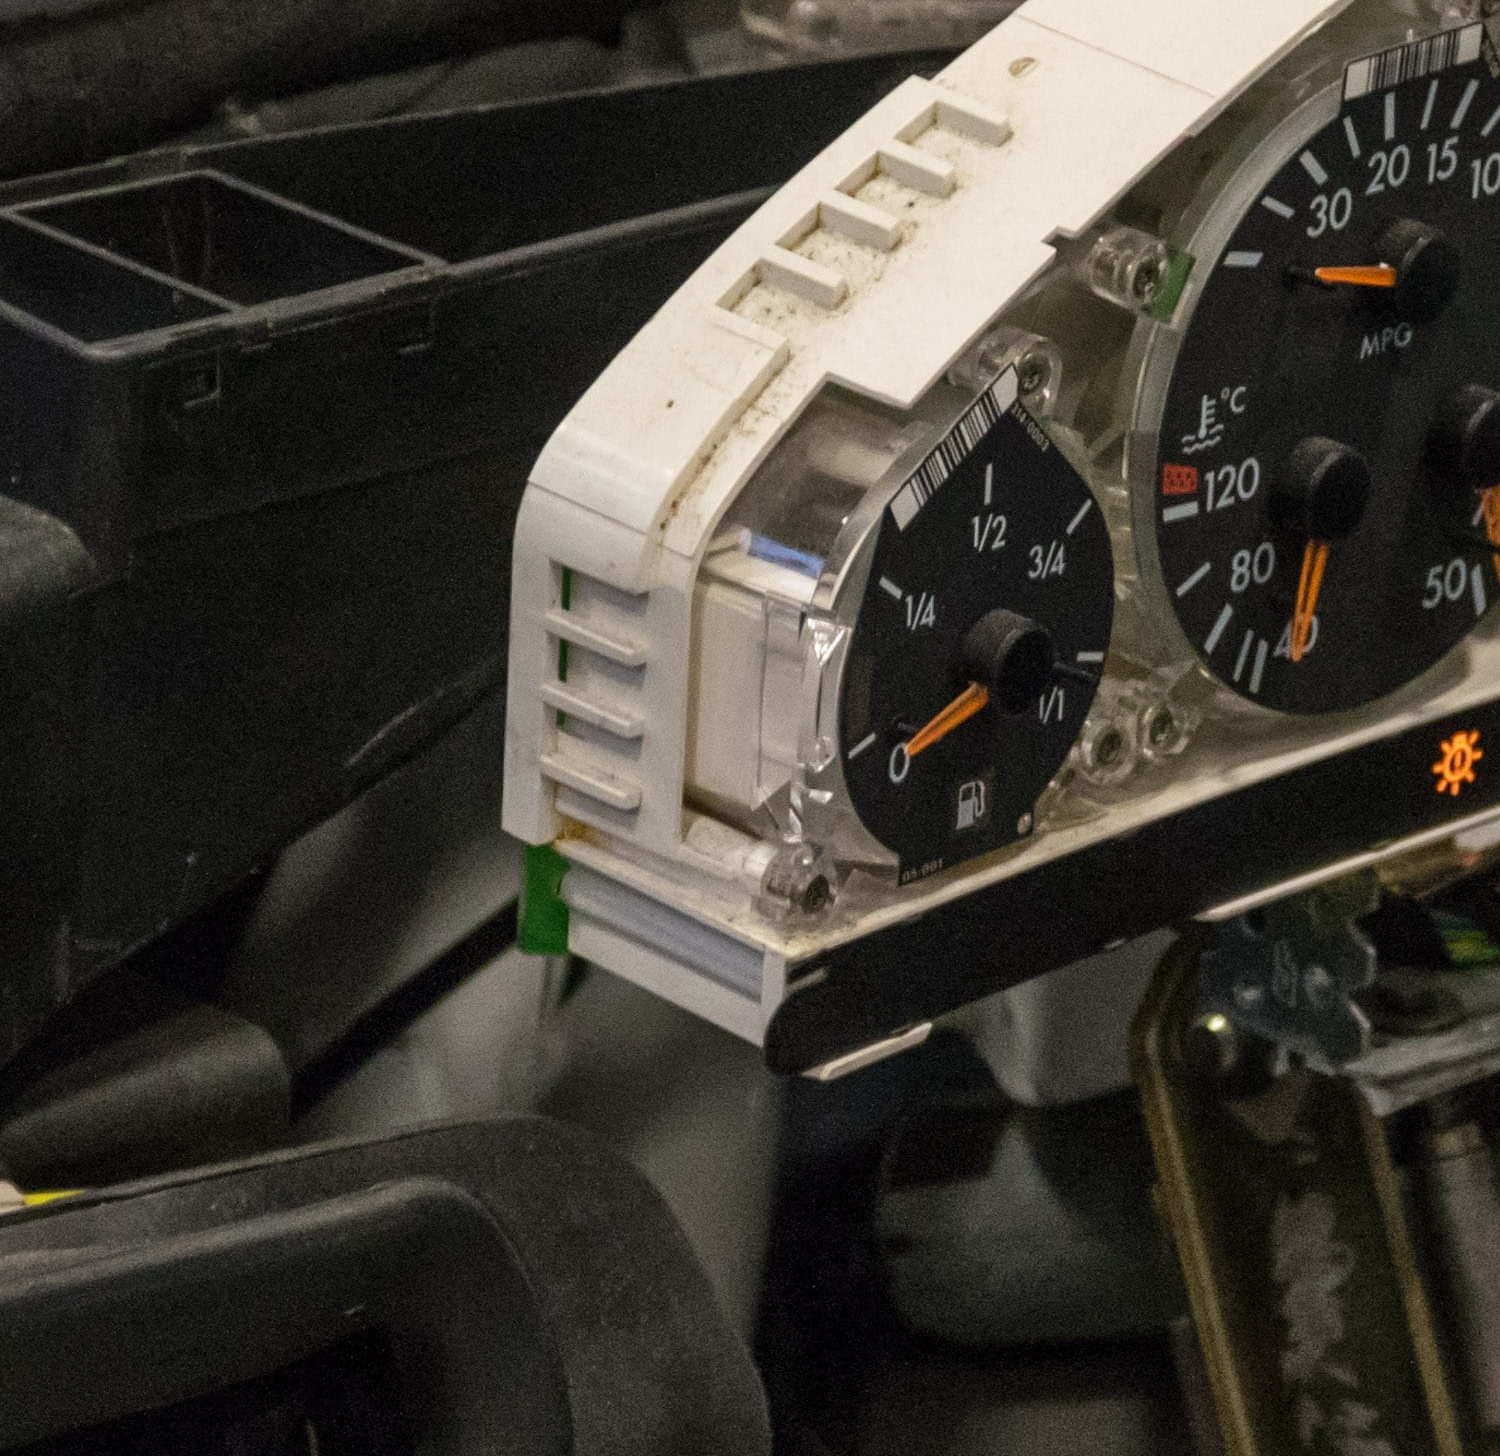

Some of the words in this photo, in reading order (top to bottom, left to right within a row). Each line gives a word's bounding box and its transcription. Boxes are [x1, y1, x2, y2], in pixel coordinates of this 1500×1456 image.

[1365, 145, 1411, 194] 20
[1427, 137, 1460, 182] 15
[1306, 188, 1353, 238] 30
[1360, 322, 1413, 358] MPG
[1204, 458, 1261, 512] 120
[972, 514, 1008, 553] 1/2
[1028, 542, 1067, 579] 3/4
[1230, 543, 1275, 593] 80
[1422, 560, 1467, 609] 50
[905, 595, 937, 630] 1/4
[1038, 686, 1065, 724] 1/1
[889, 742, 910, 783] 0
